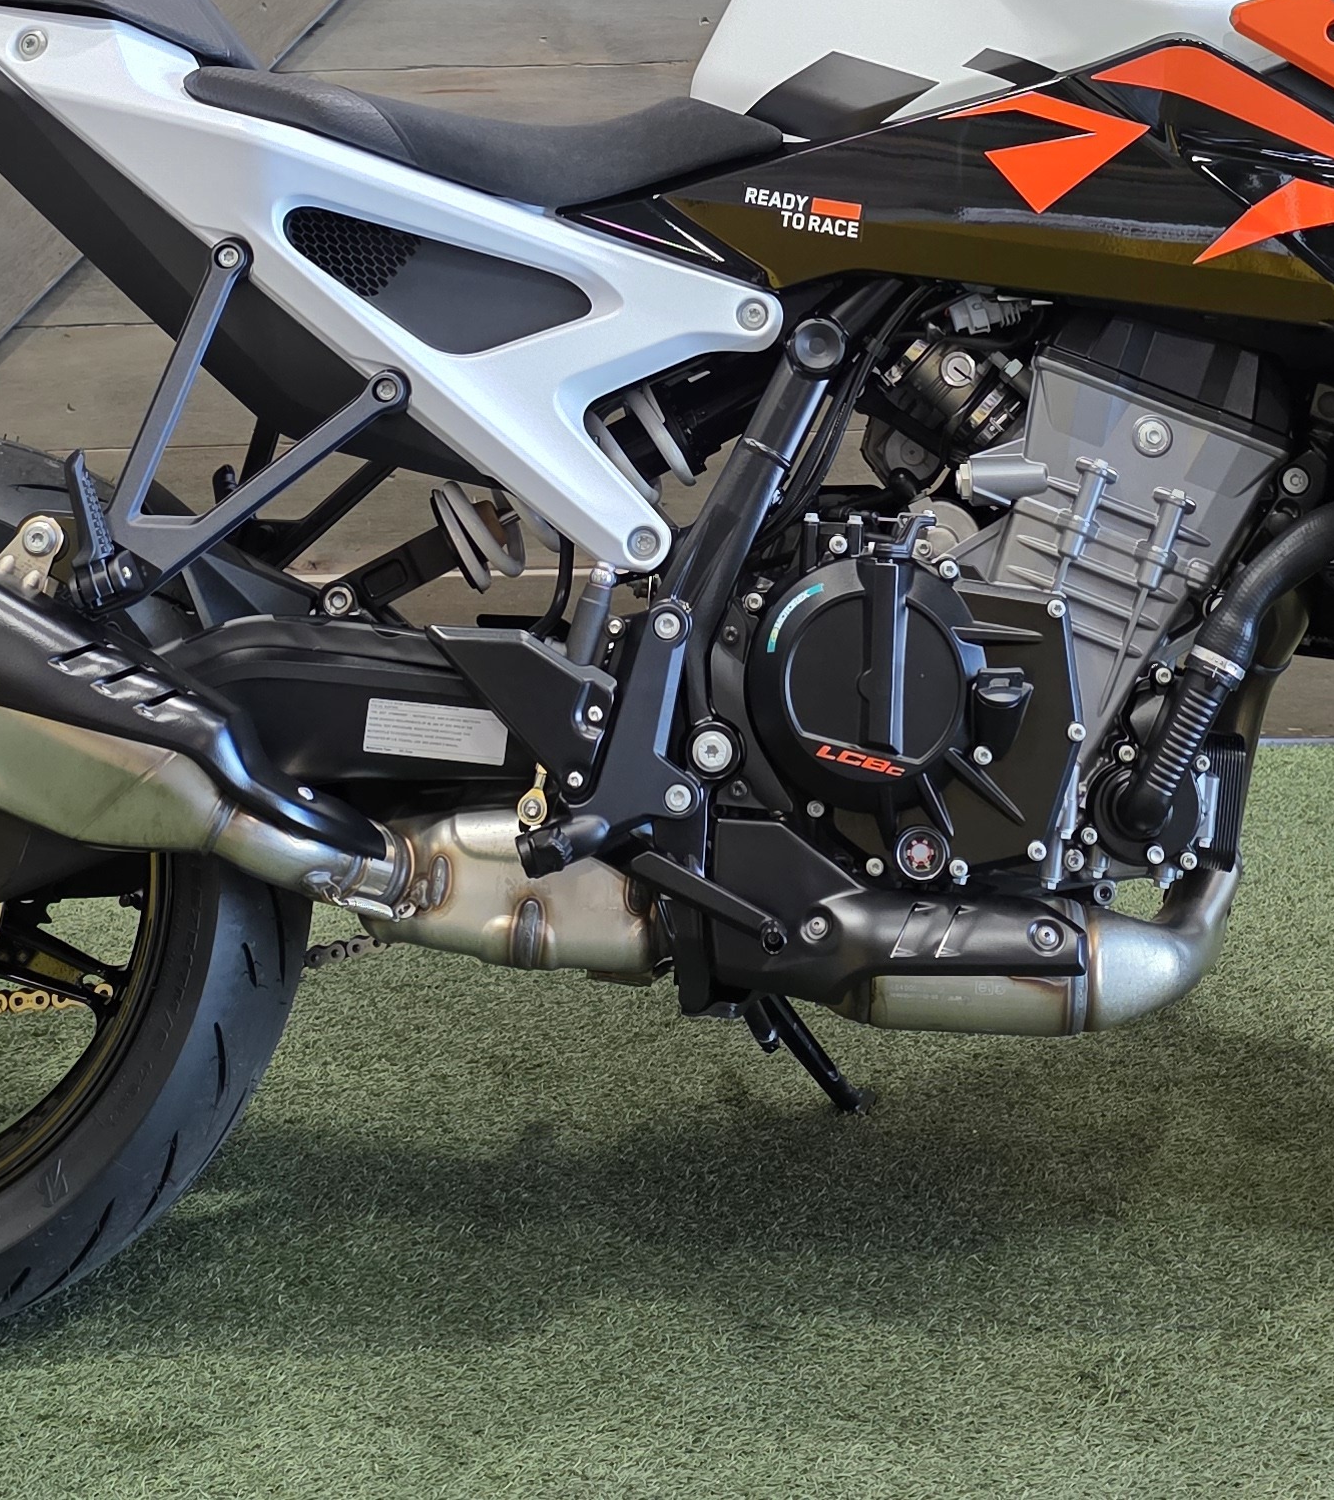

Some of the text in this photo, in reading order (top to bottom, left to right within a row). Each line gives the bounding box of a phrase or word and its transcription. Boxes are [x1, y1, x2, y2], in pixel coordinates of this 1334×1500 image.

[744, 186, 809, 211] READY
[780, 210, 859, 238] TO RACE
